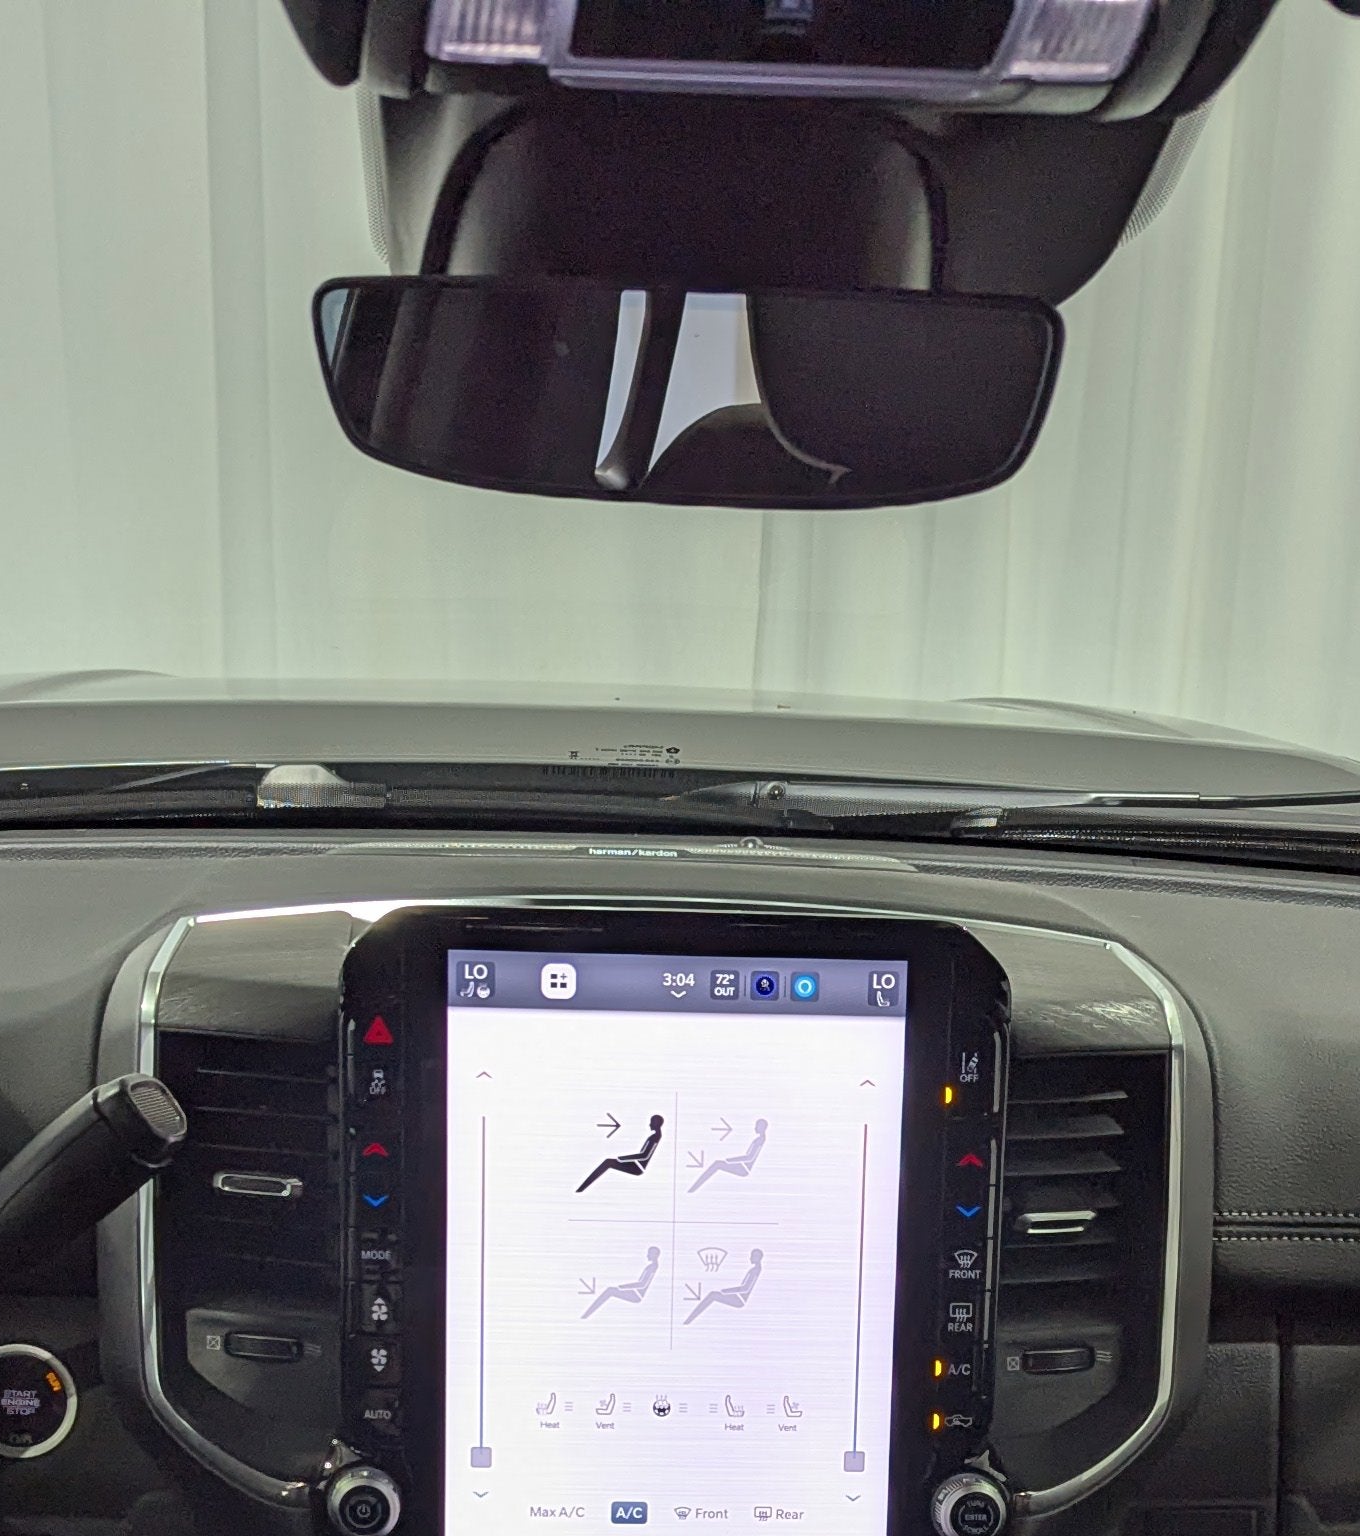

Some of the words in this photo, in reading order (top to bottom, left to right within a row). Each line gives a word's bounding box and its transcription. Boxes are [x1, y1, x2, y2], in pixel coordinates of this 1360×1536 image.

[588, 848, 678, 857] harman/kardon
[464, 964, 488, 979] LO
[663, 973, 695, 986] 3:04
[873, 973, 896, 989] LO
[714, 986, 735, 996] OUT
[959, 1074, 979, 1083] OFF
[361, 1251, 391, 1260] MODE
[949, 1270, 981, 1279] FRONT
[948, 1323, 972, 1332] REAR
[948, 1364, 970, 1376] A/C
[4, 1390, 37, 1399] START
[364, 1410, 392, 1419] AUTO
[540, 1421, 560, 1429] Heat
[596, 1422, 615, 1430] Vent
[725, 1423, 744, 1431] Heat
[778, 1424, 797, 1432] Vent
[529, 1506, 559, 1518] Max
[560, 1506, 585, 1518] A/C
[616, 1505, 643, 1519] A/C
[695, 1507, 728, 1520] Front
[776, 1508, 804, 1520] Rear
